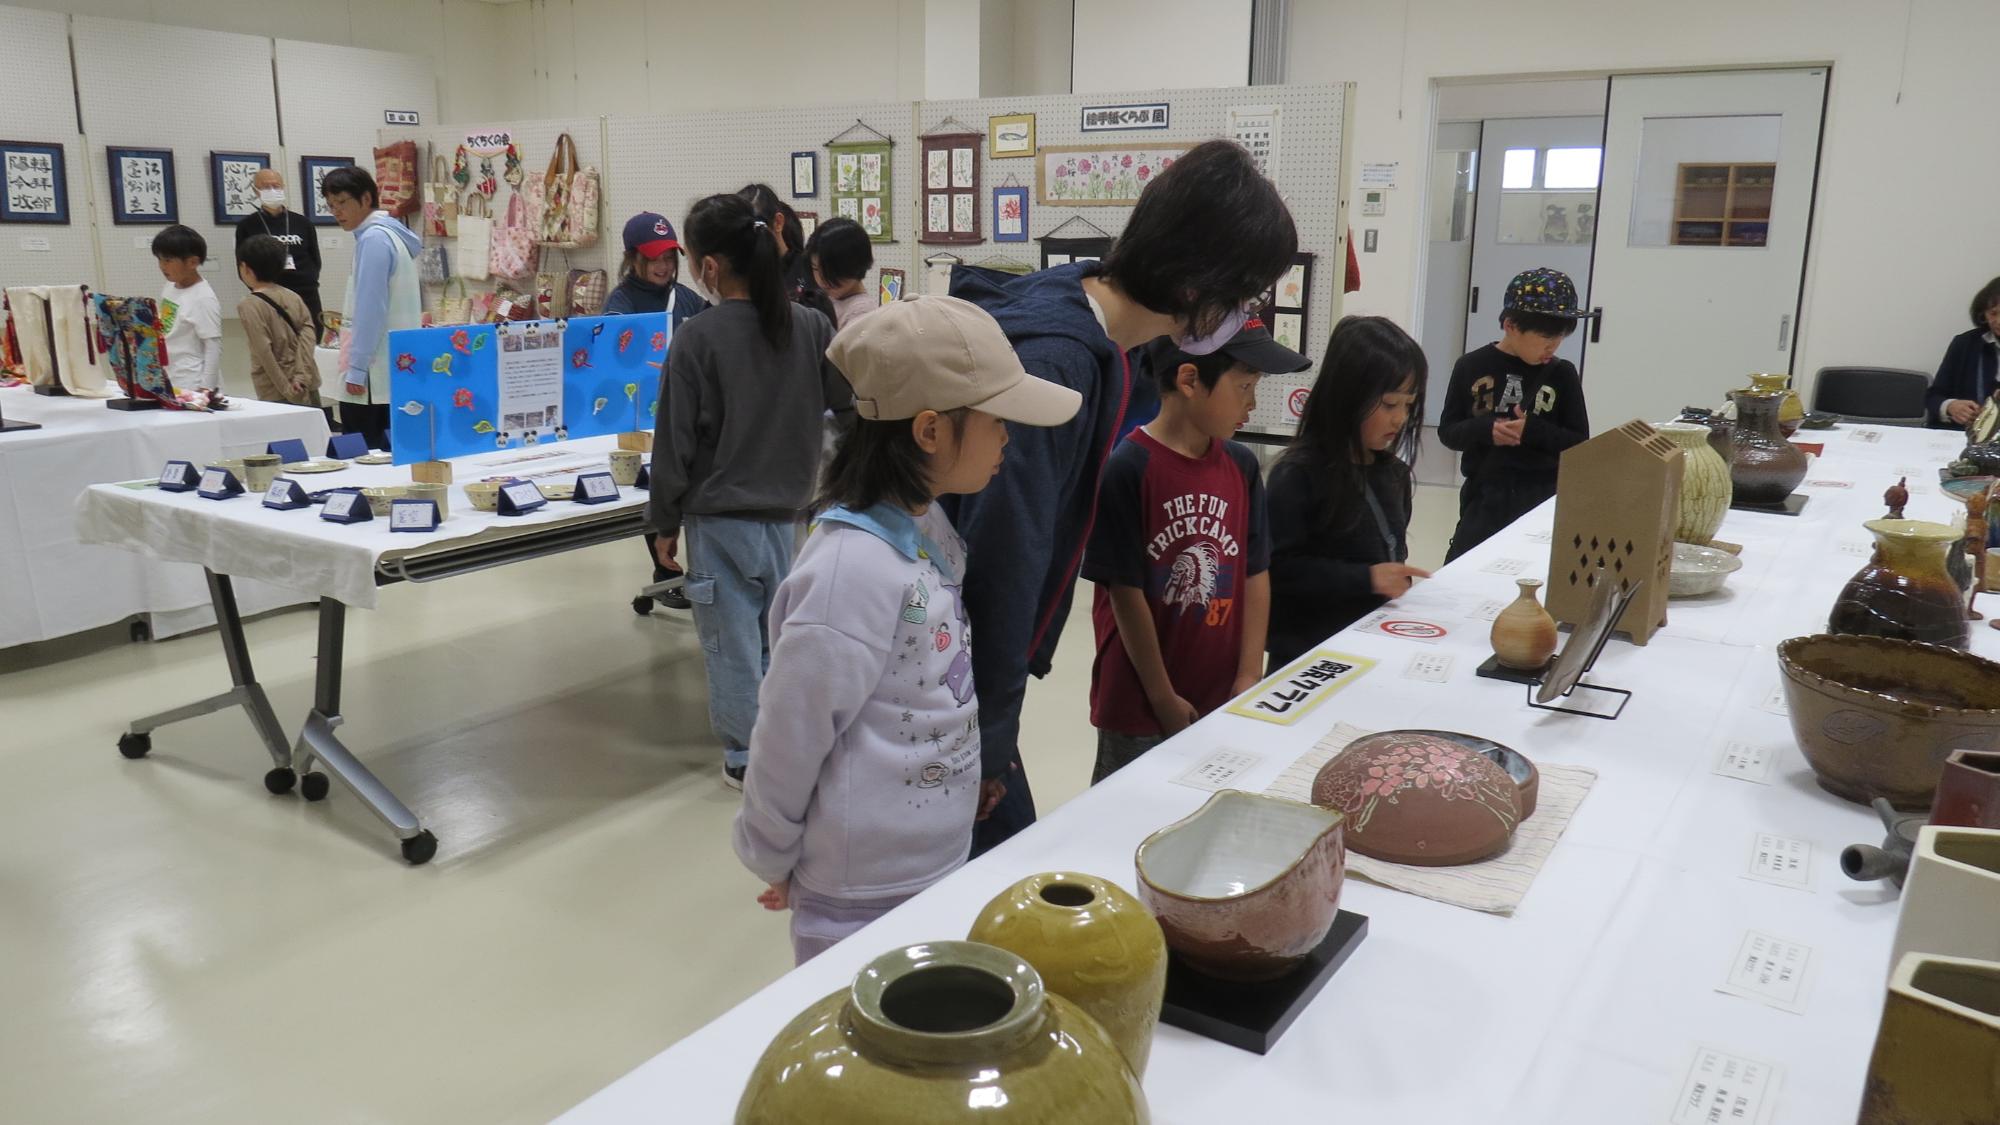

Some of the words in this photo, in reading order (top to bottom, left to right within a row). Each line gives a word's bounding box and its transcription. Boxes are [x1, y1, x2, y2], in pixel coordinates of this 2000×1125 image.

[467, 133, 510, 148] ちくちくの会
[1471, 373, 1557, 416] GAP
[1163, 494, 1195, 520] THE
[1198, 493, 1228, 520] FUN
[1206, 599, 1233, 626] 87
[1254, 660, 1353, 713] 陶友クラブ
